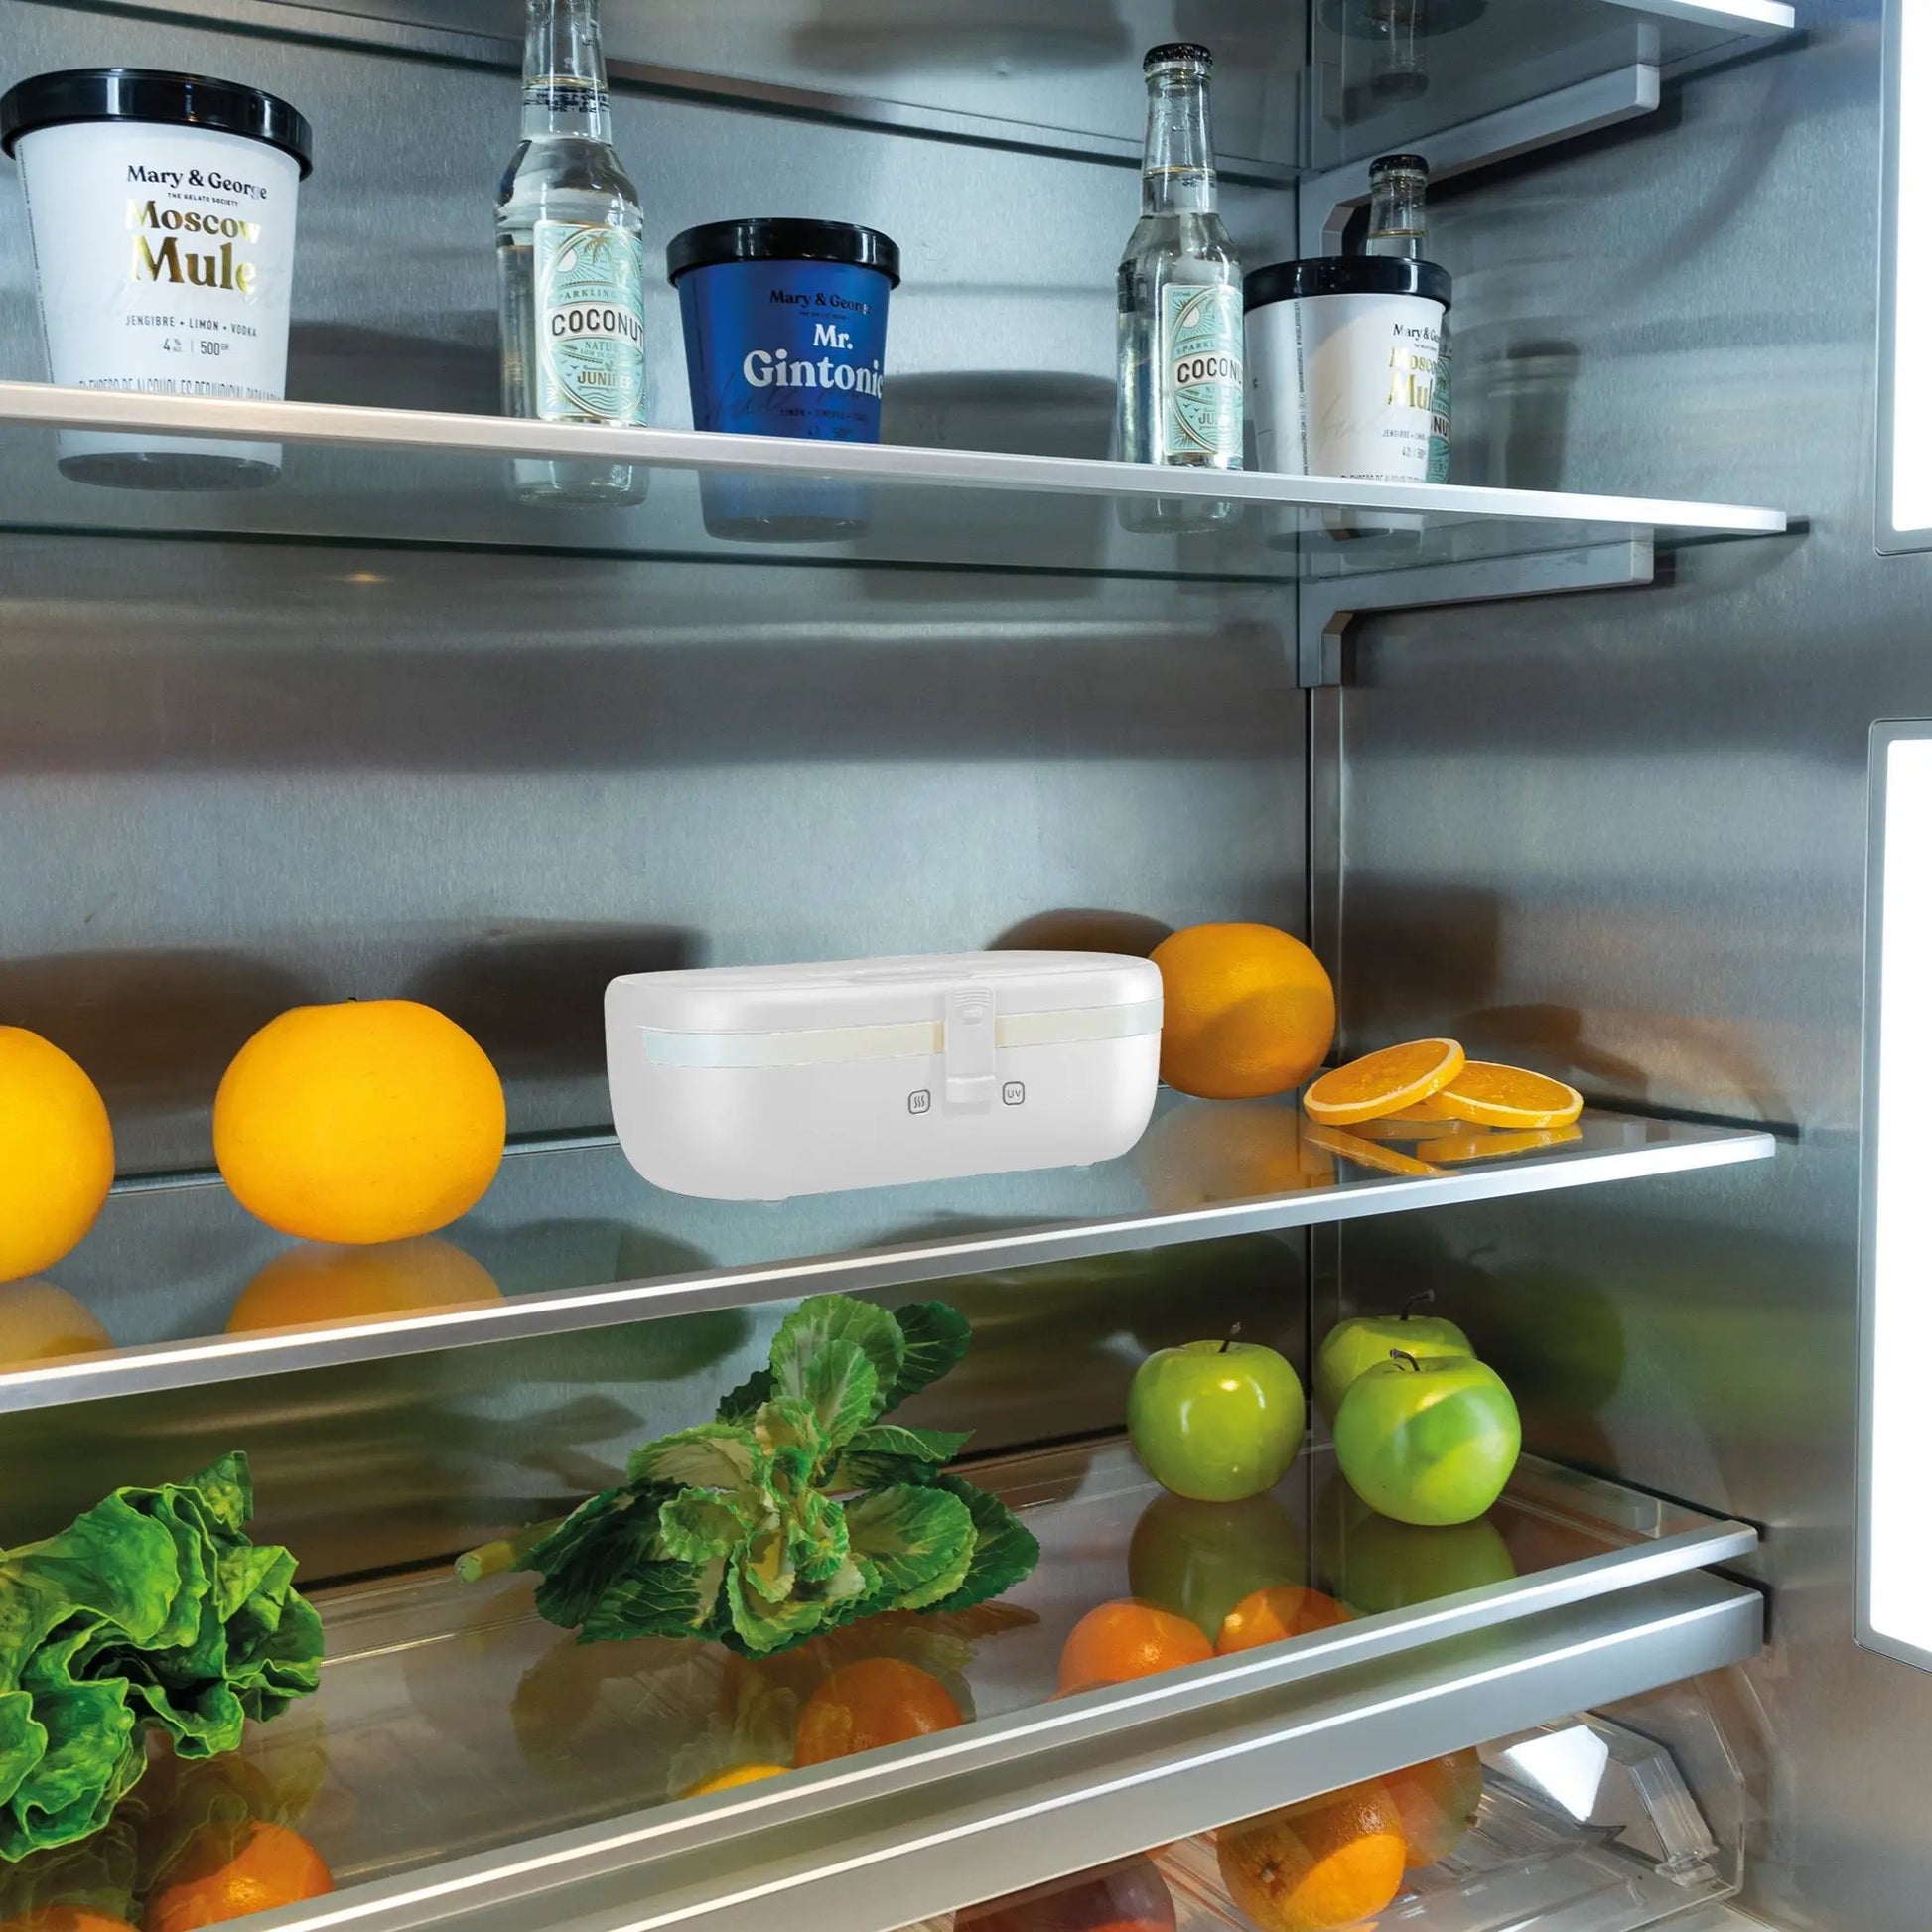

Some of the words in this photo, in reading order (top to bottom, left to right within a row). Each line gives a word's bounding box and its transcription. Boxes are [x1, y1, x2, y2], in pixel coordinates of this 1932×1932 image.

[127, 165, 183, 189] Mary
[188, 169, 205, 187] &
[208, 171, 267, 200] George
[212, 197, 238, 207] SOCIETY
[131, 235, 256, 295] Mule
[770, 289, 810, 308] Mary
[815, 292, 827, 307] &
[125, 315, 175, 327] JENGIBRE
[552, 309, 643, 347] COCONUT
[813, 323, 853, 349] Mr.
[743, 348, 883, 399] Gintonic
[1008, 1089, 1021, 1099] UV
